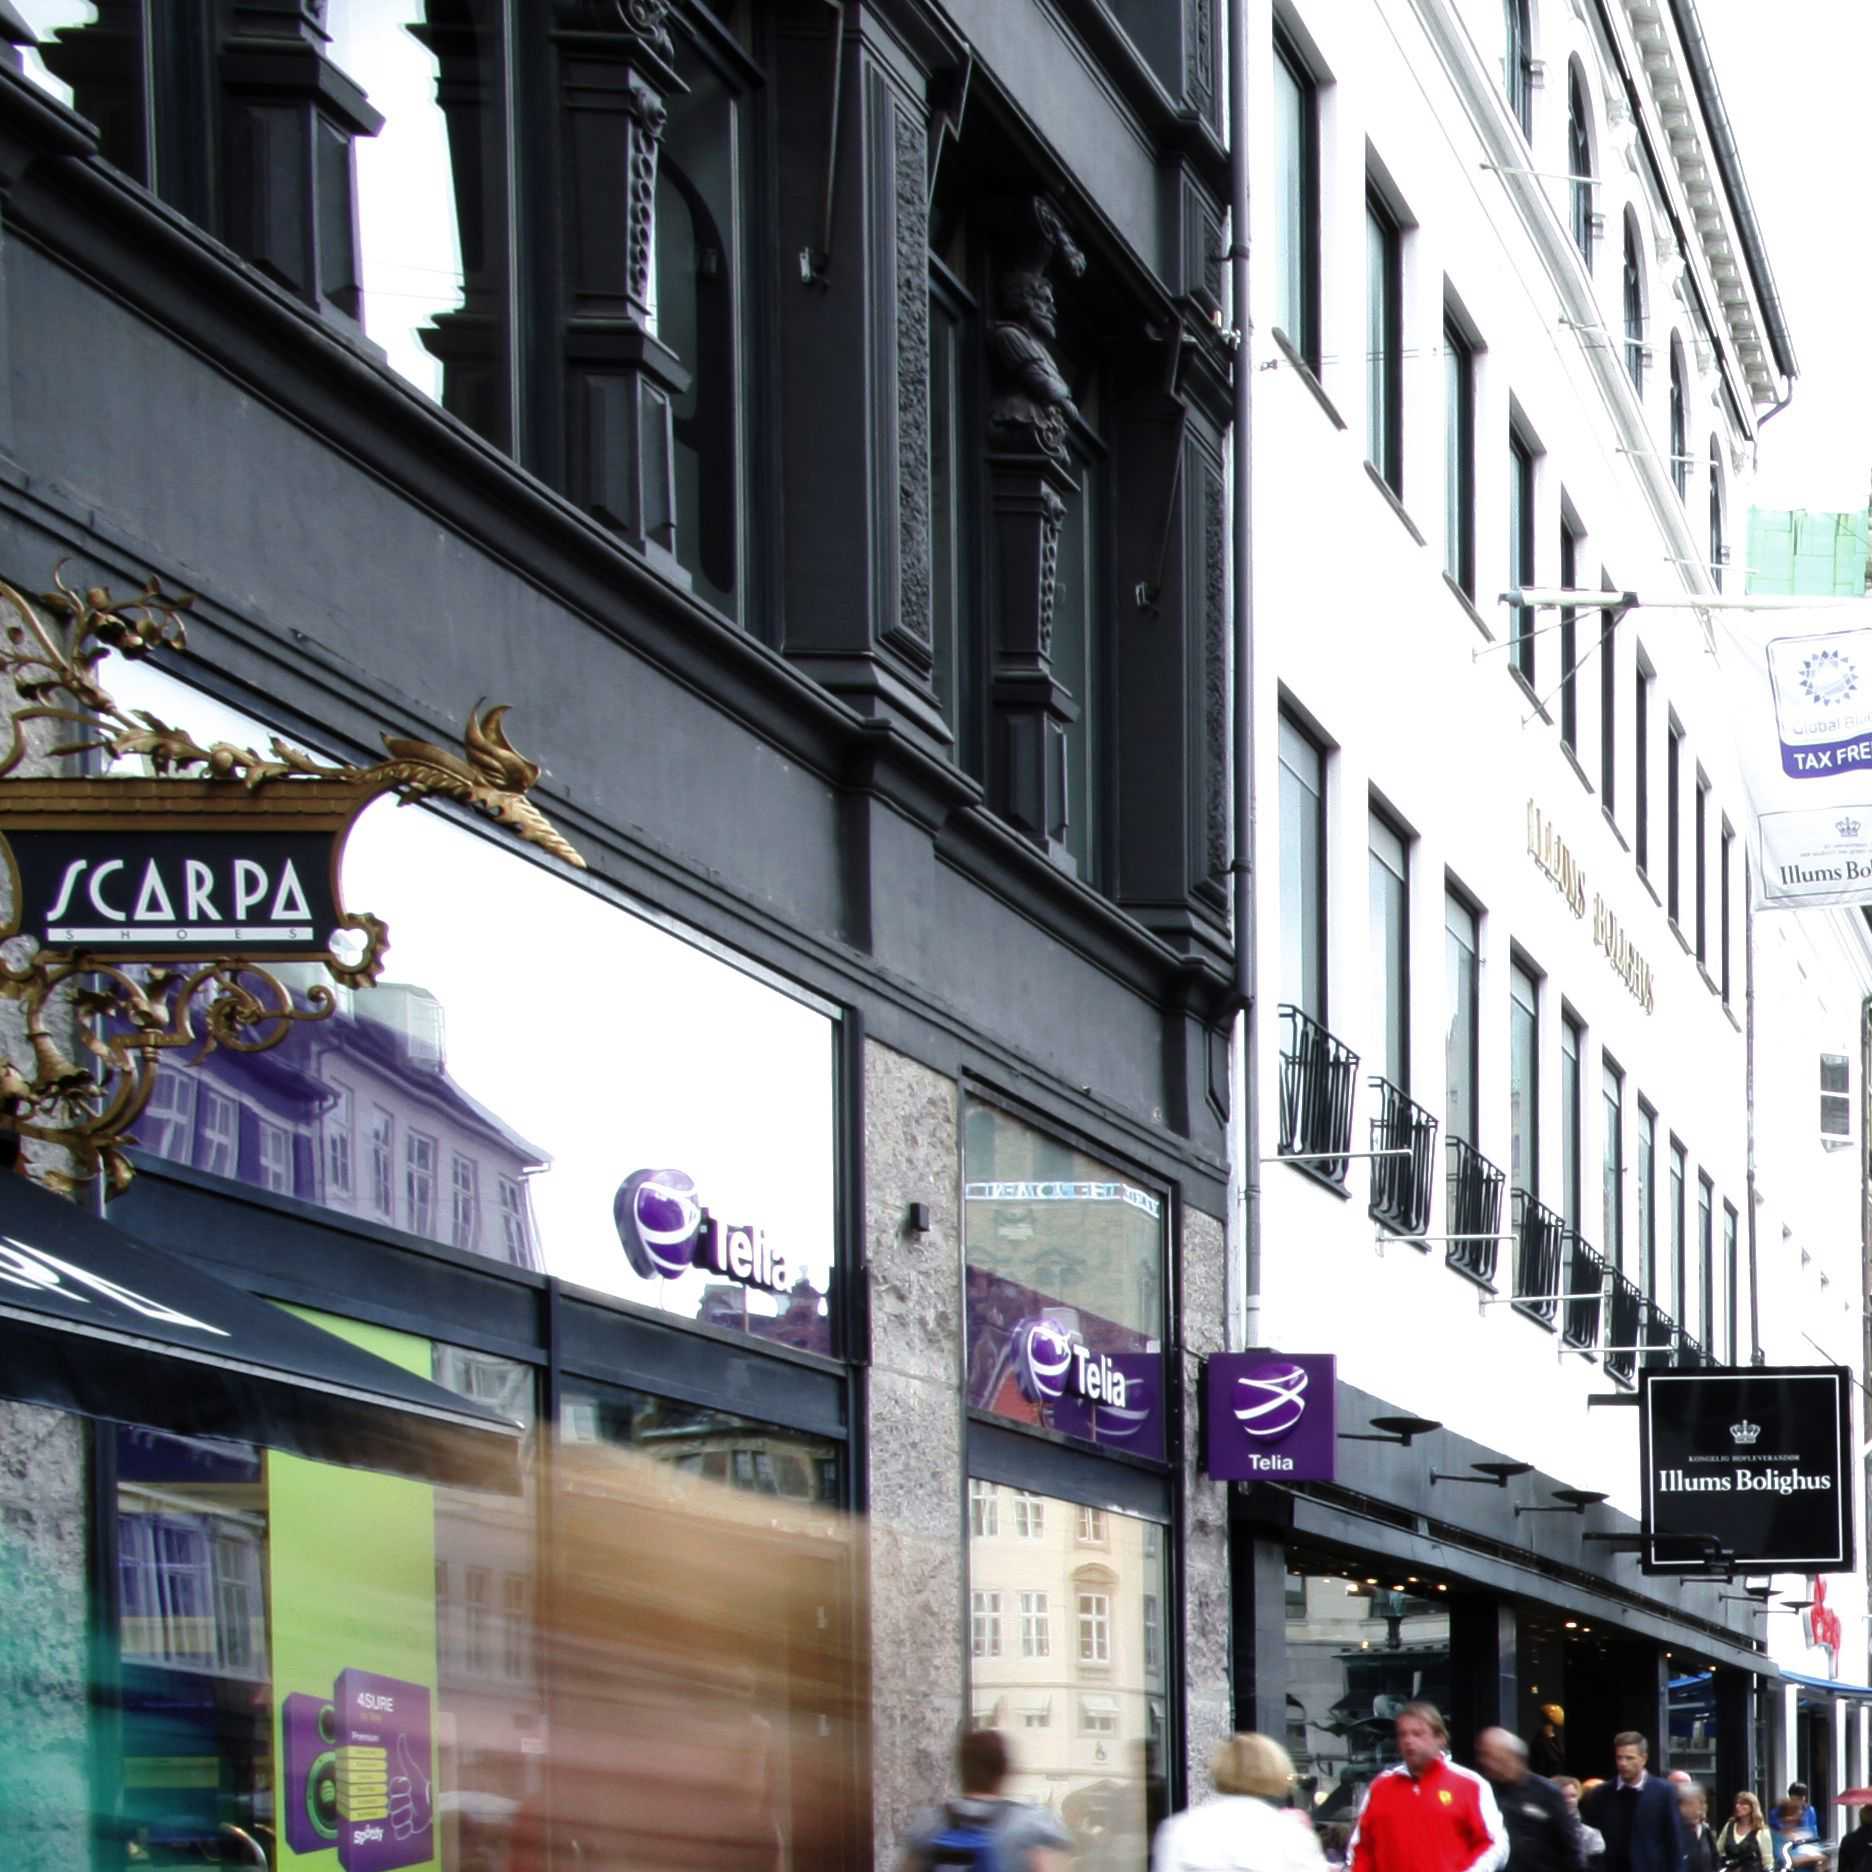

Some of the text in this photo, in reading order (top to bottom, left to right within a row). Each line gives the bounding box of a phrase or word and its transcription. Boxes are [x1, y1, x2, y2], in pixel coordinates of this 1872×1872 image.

[1793, 750, 1833, 770] TAX
[1779, 864, 1843, 886] Illums
[46, 857, 313, 922] SCARPA
[64, 928, 298, 940] SHOES
[1073, 1345, 1126, 1408] Telia
[1249, 1454, 1294, 1471] Telia
[1659, 1468, 1831, 1496] Illums Bolighus
[356, 1692, 395, 1713] 4SURE
